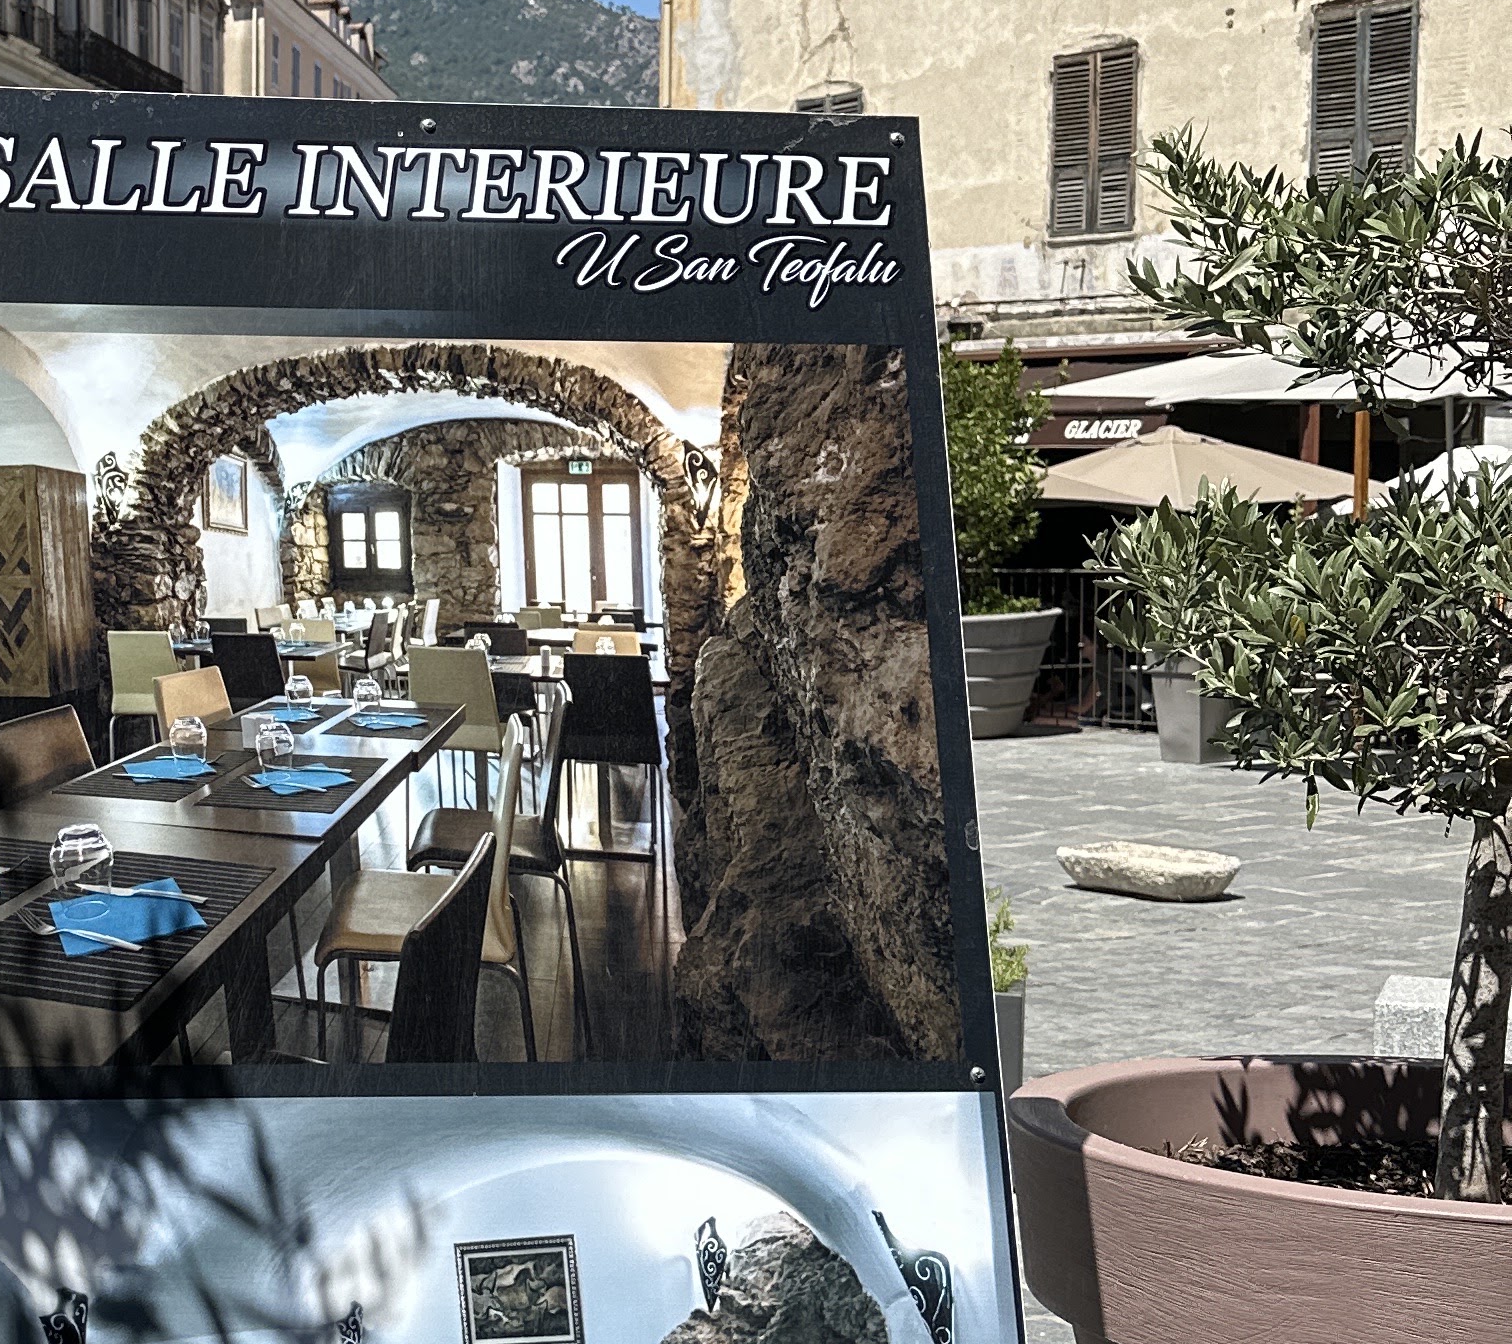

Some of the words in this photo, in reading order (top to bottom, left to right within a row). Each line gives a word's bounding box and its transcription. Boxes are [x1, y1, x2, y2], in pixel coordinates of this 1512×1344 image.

[287, 143, 892, 227] INTERIEURE
[555, 231, 641, 287] U
[633, 234, 741, 292] San
[748, 235, 901, 309] Teofalu
[1064, 419, 1142, 439] GLACIER
